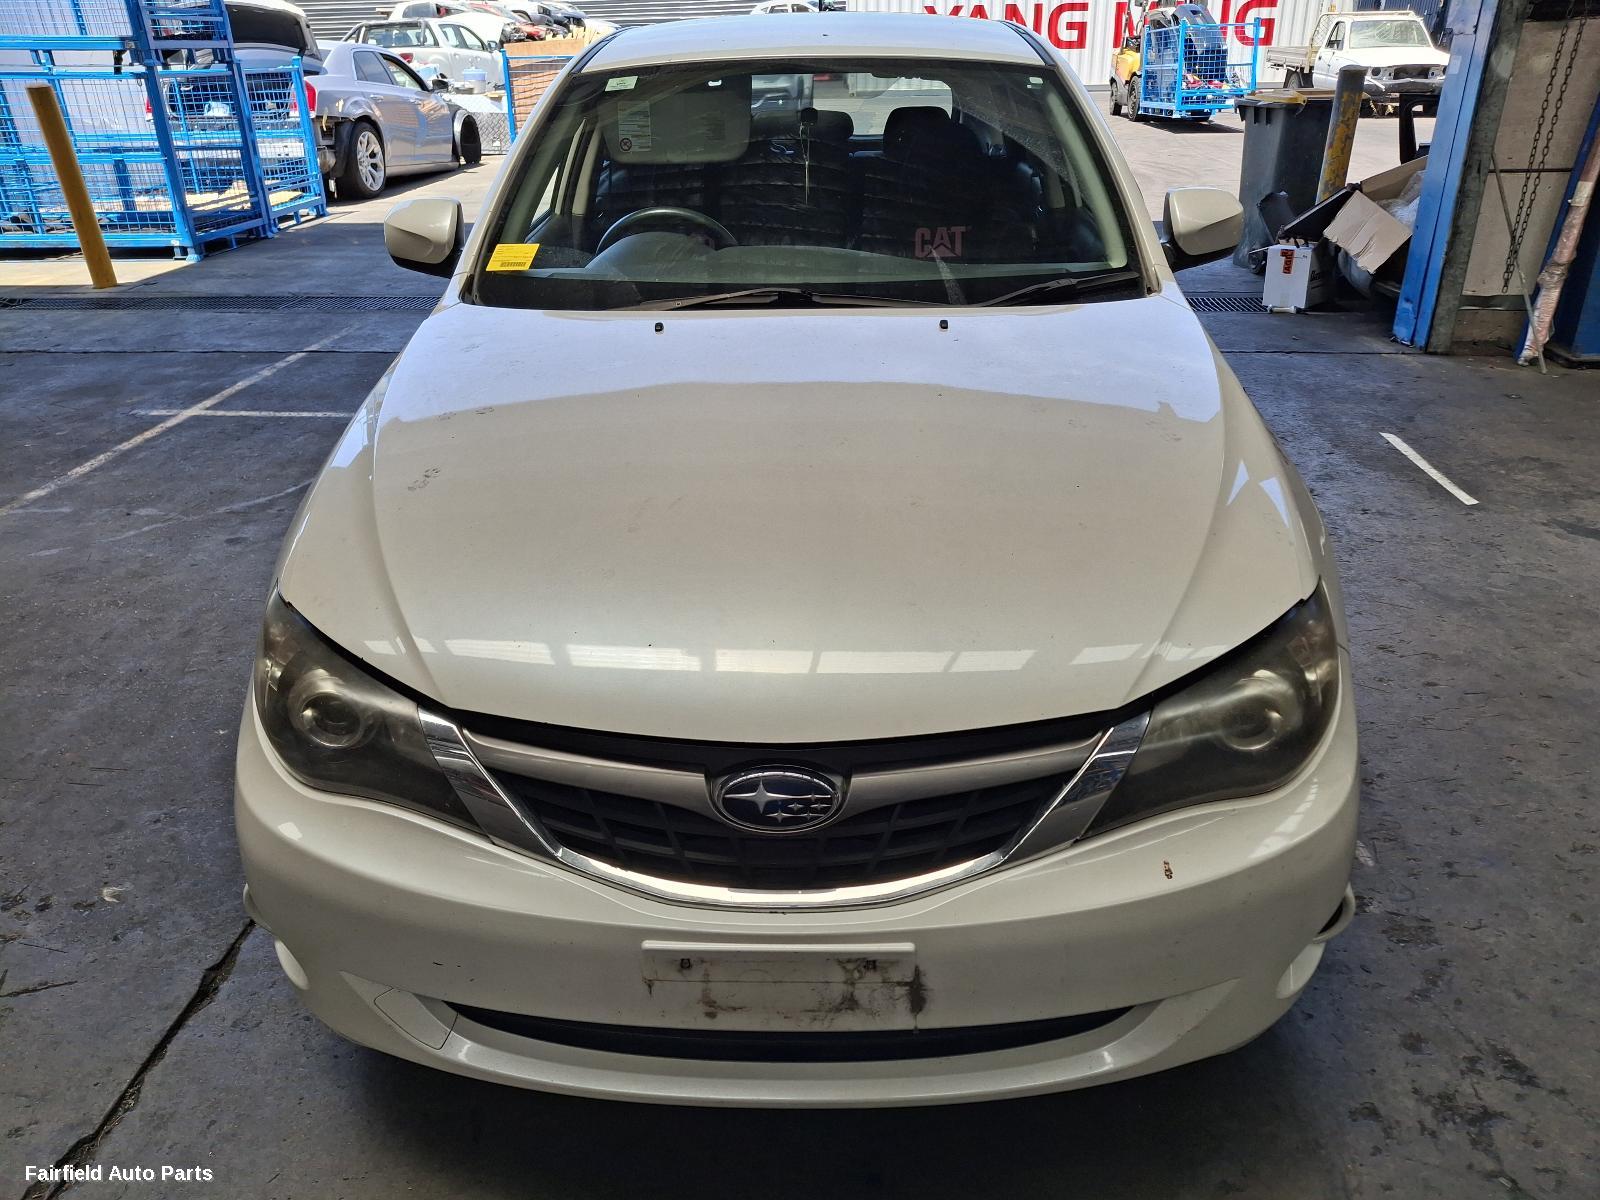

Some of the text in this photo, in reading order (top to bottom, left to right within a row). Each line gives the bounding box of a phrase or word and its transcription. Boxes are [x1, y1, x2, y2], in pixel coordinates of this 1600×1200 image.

[924, 0, 1278, 49] NG MG
[914, 226, 966, 258] CAT
